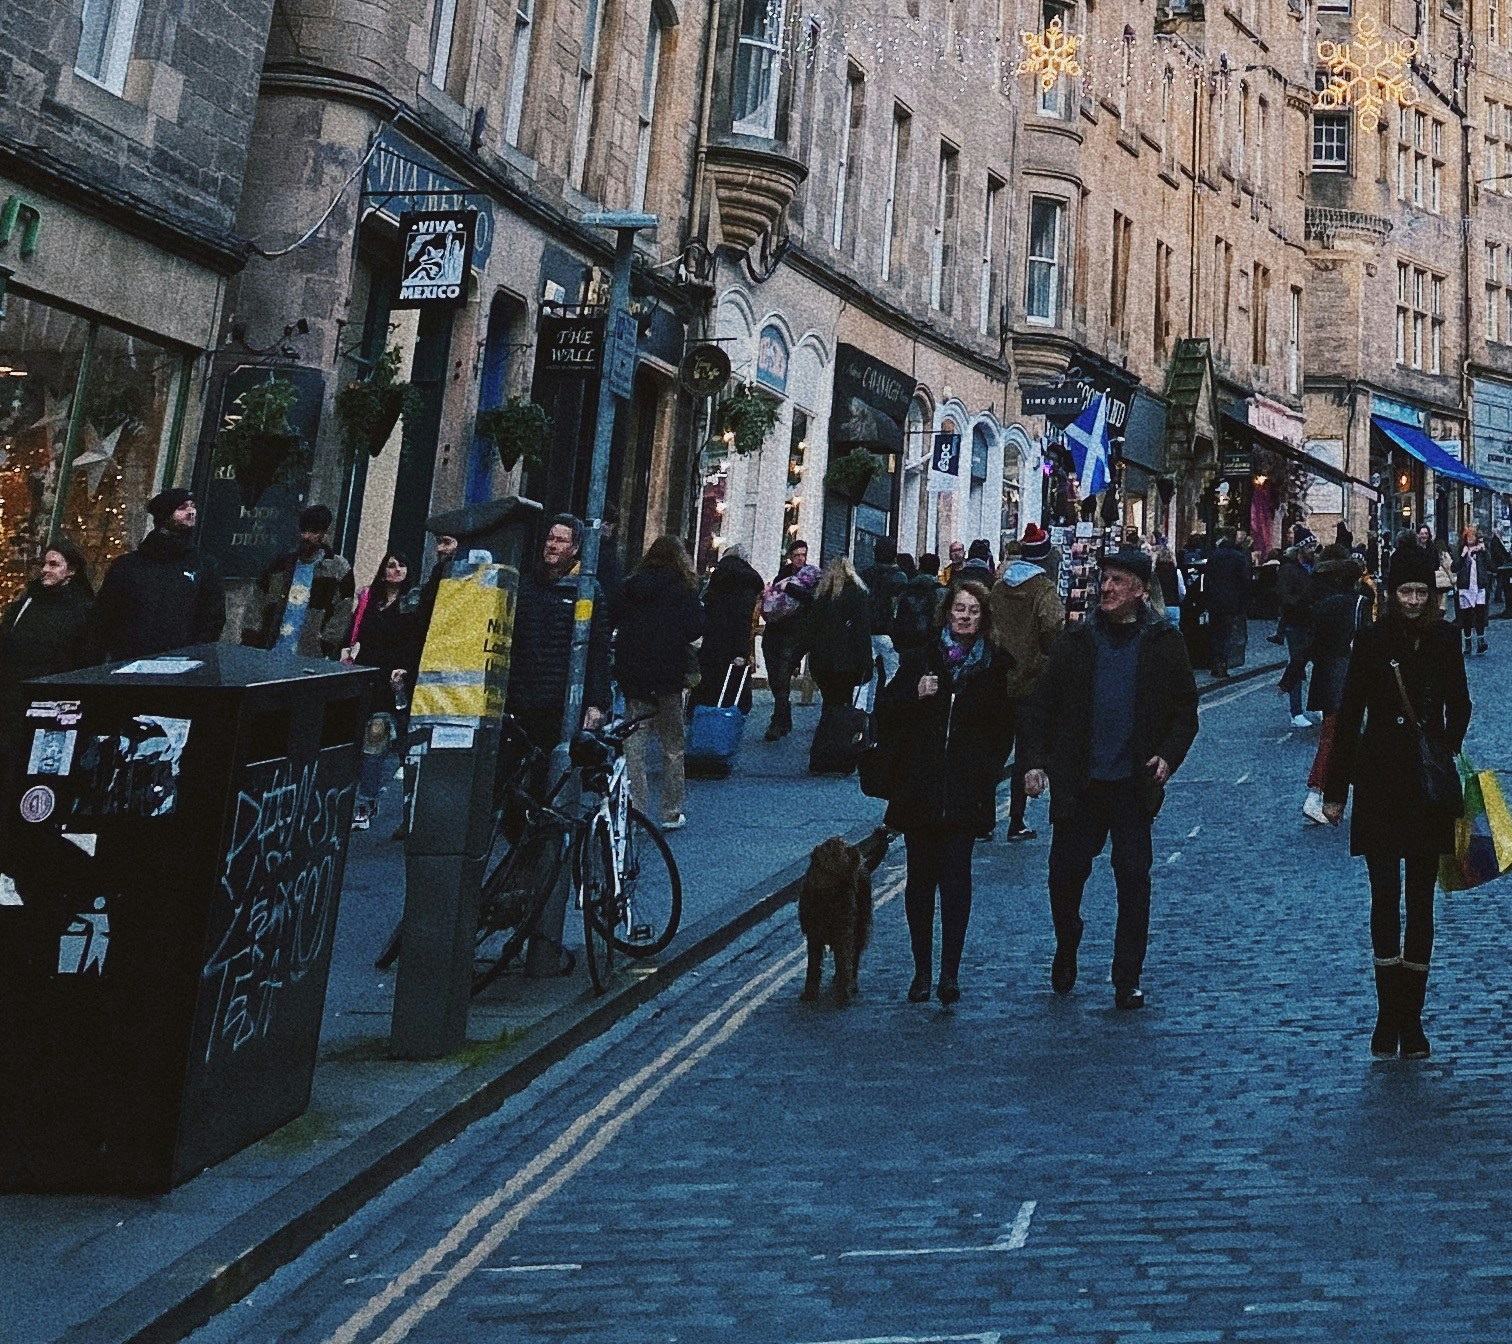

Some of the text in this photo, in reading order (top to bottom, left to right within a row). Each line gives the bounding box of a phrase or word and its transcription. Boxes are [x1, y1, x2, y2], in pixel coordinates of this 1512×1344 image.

[418, 220, 458, 233] VIVA
[400, 285, 460, 300] MEXICO
[556, 328, 594, 345] THE
[551, 348, 596, 363] WALL
[938, 443, 951, 472] espc
